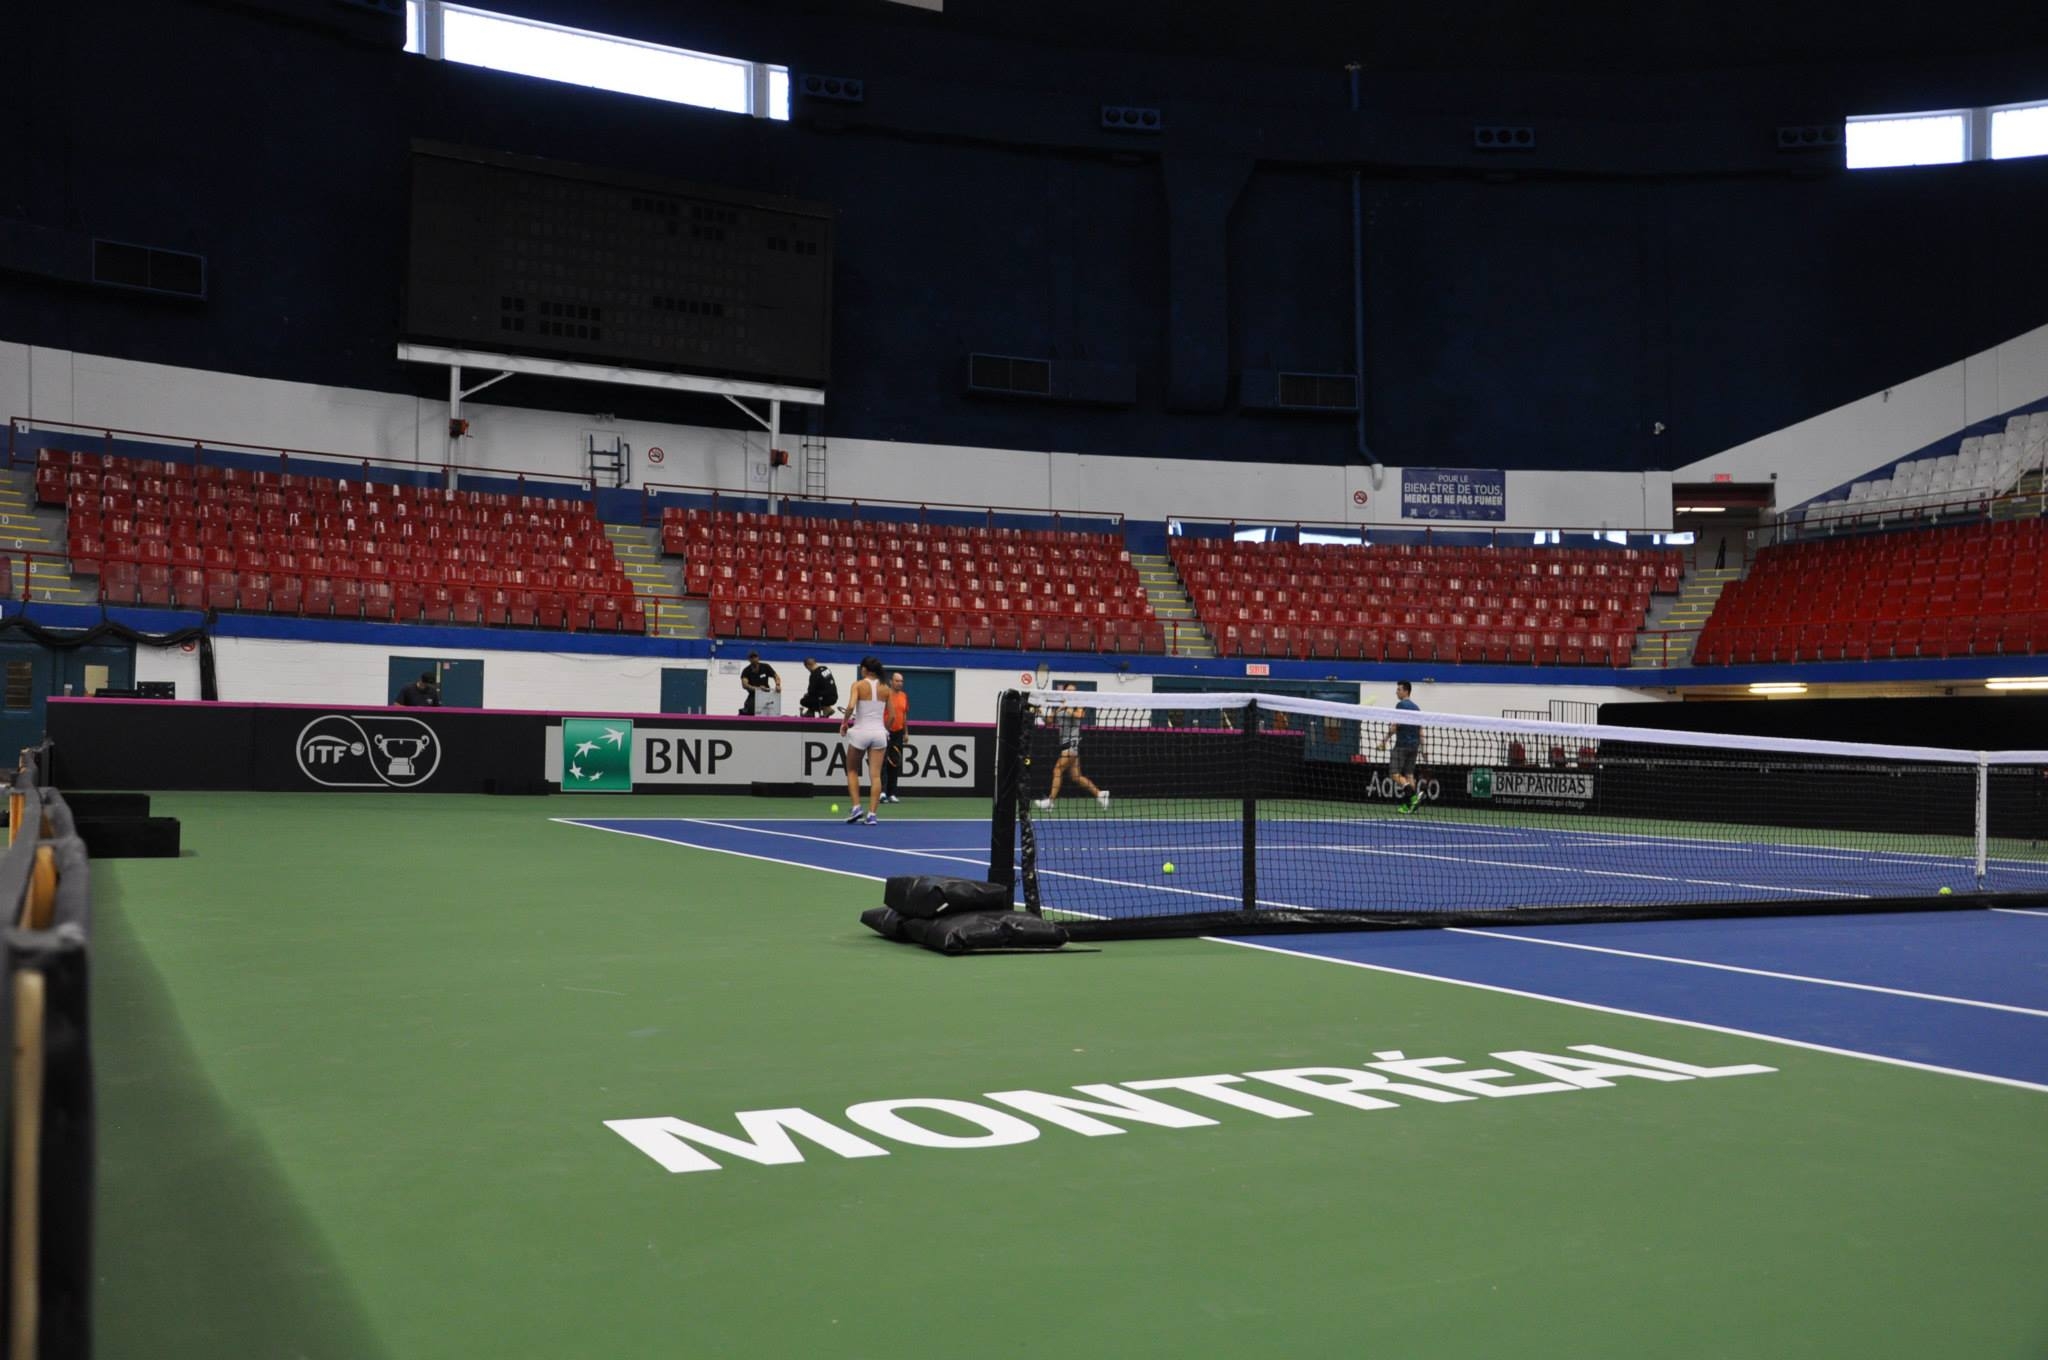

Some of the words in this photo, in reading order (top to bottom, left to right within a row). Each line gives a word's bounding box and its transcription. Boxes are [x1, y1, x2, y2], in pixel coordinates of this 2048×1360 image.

[1404, 481, 1455, 494] BIEN-ÊTRE
[1457, 484, 1471, 494] DE
[1438, 474, 1459, 483] POUR
[1460, 475, 1469, 483] LE
[1404, 493, 1430, 504] MERCI
[1431, 494, 1442, 504] DE
[1443, 495, 1455, 505] NE
[1456, 495, 1473, 505] PAS
[1474, 495, 1503, 506] FUMER
[308, 745, 347, 764] ITF
[645, 738, 733, 775] BNP
[804, 741, 969, 779] PABAS
[1496, 775, 1523, 793] BNP
[1527, 776, 1586, 794] PARIBAS
[603, 1045, 1779, 1172] MONTRÉAL
